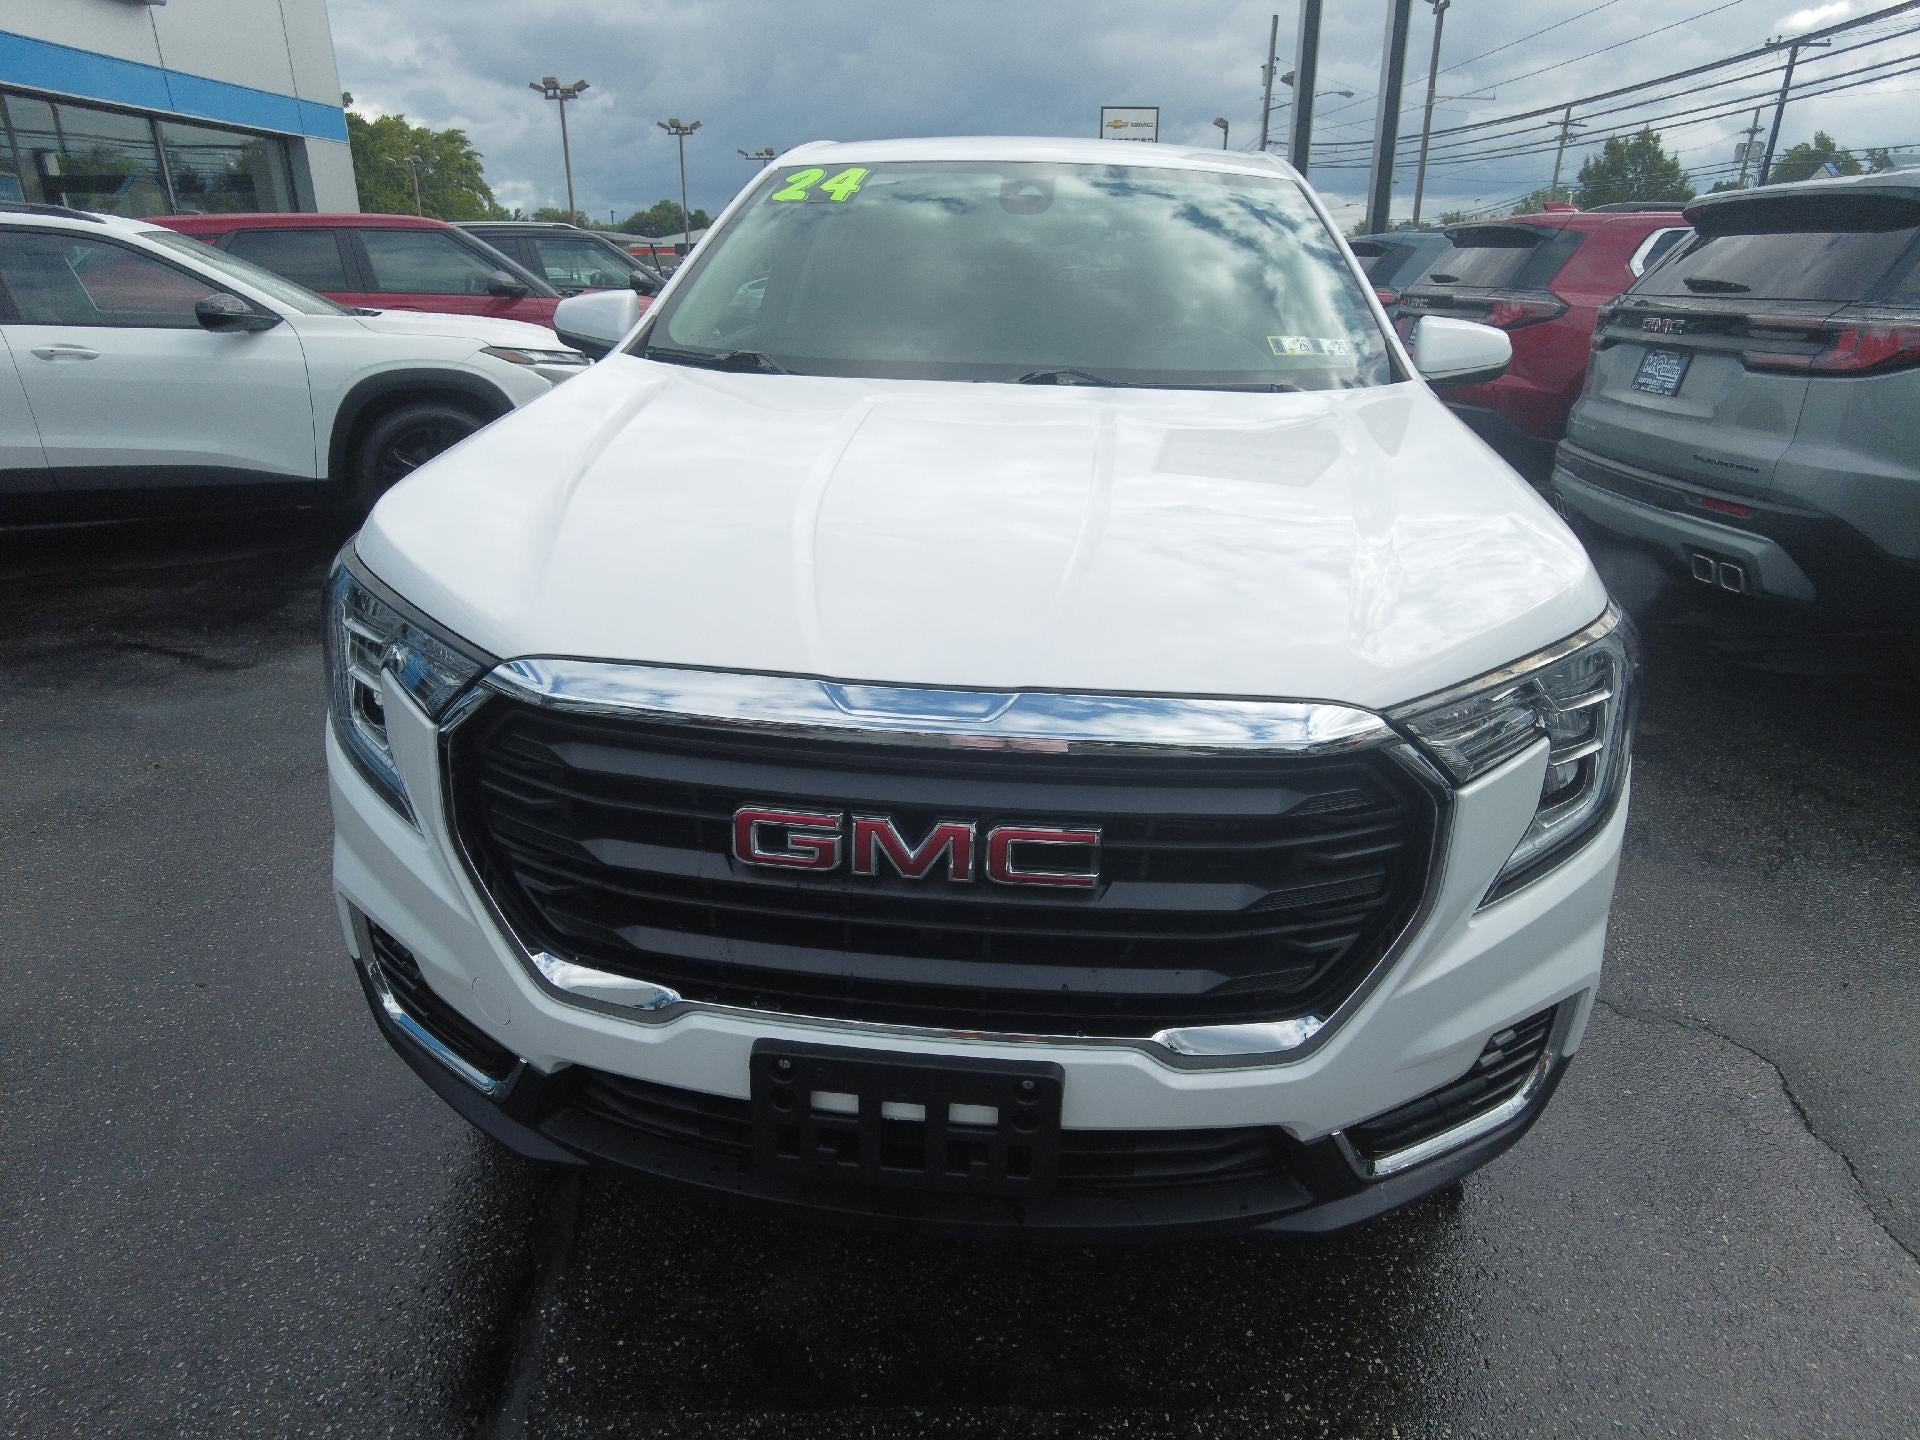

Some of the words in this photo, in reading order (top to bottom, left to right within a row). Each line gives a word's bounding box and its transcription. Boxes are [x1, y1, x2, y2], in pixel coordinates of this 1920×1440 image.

[771, 167, 872, 202] 24
[1642, 317, 1685, 335] GMC
[731, 803, 1103, 891] GMC
